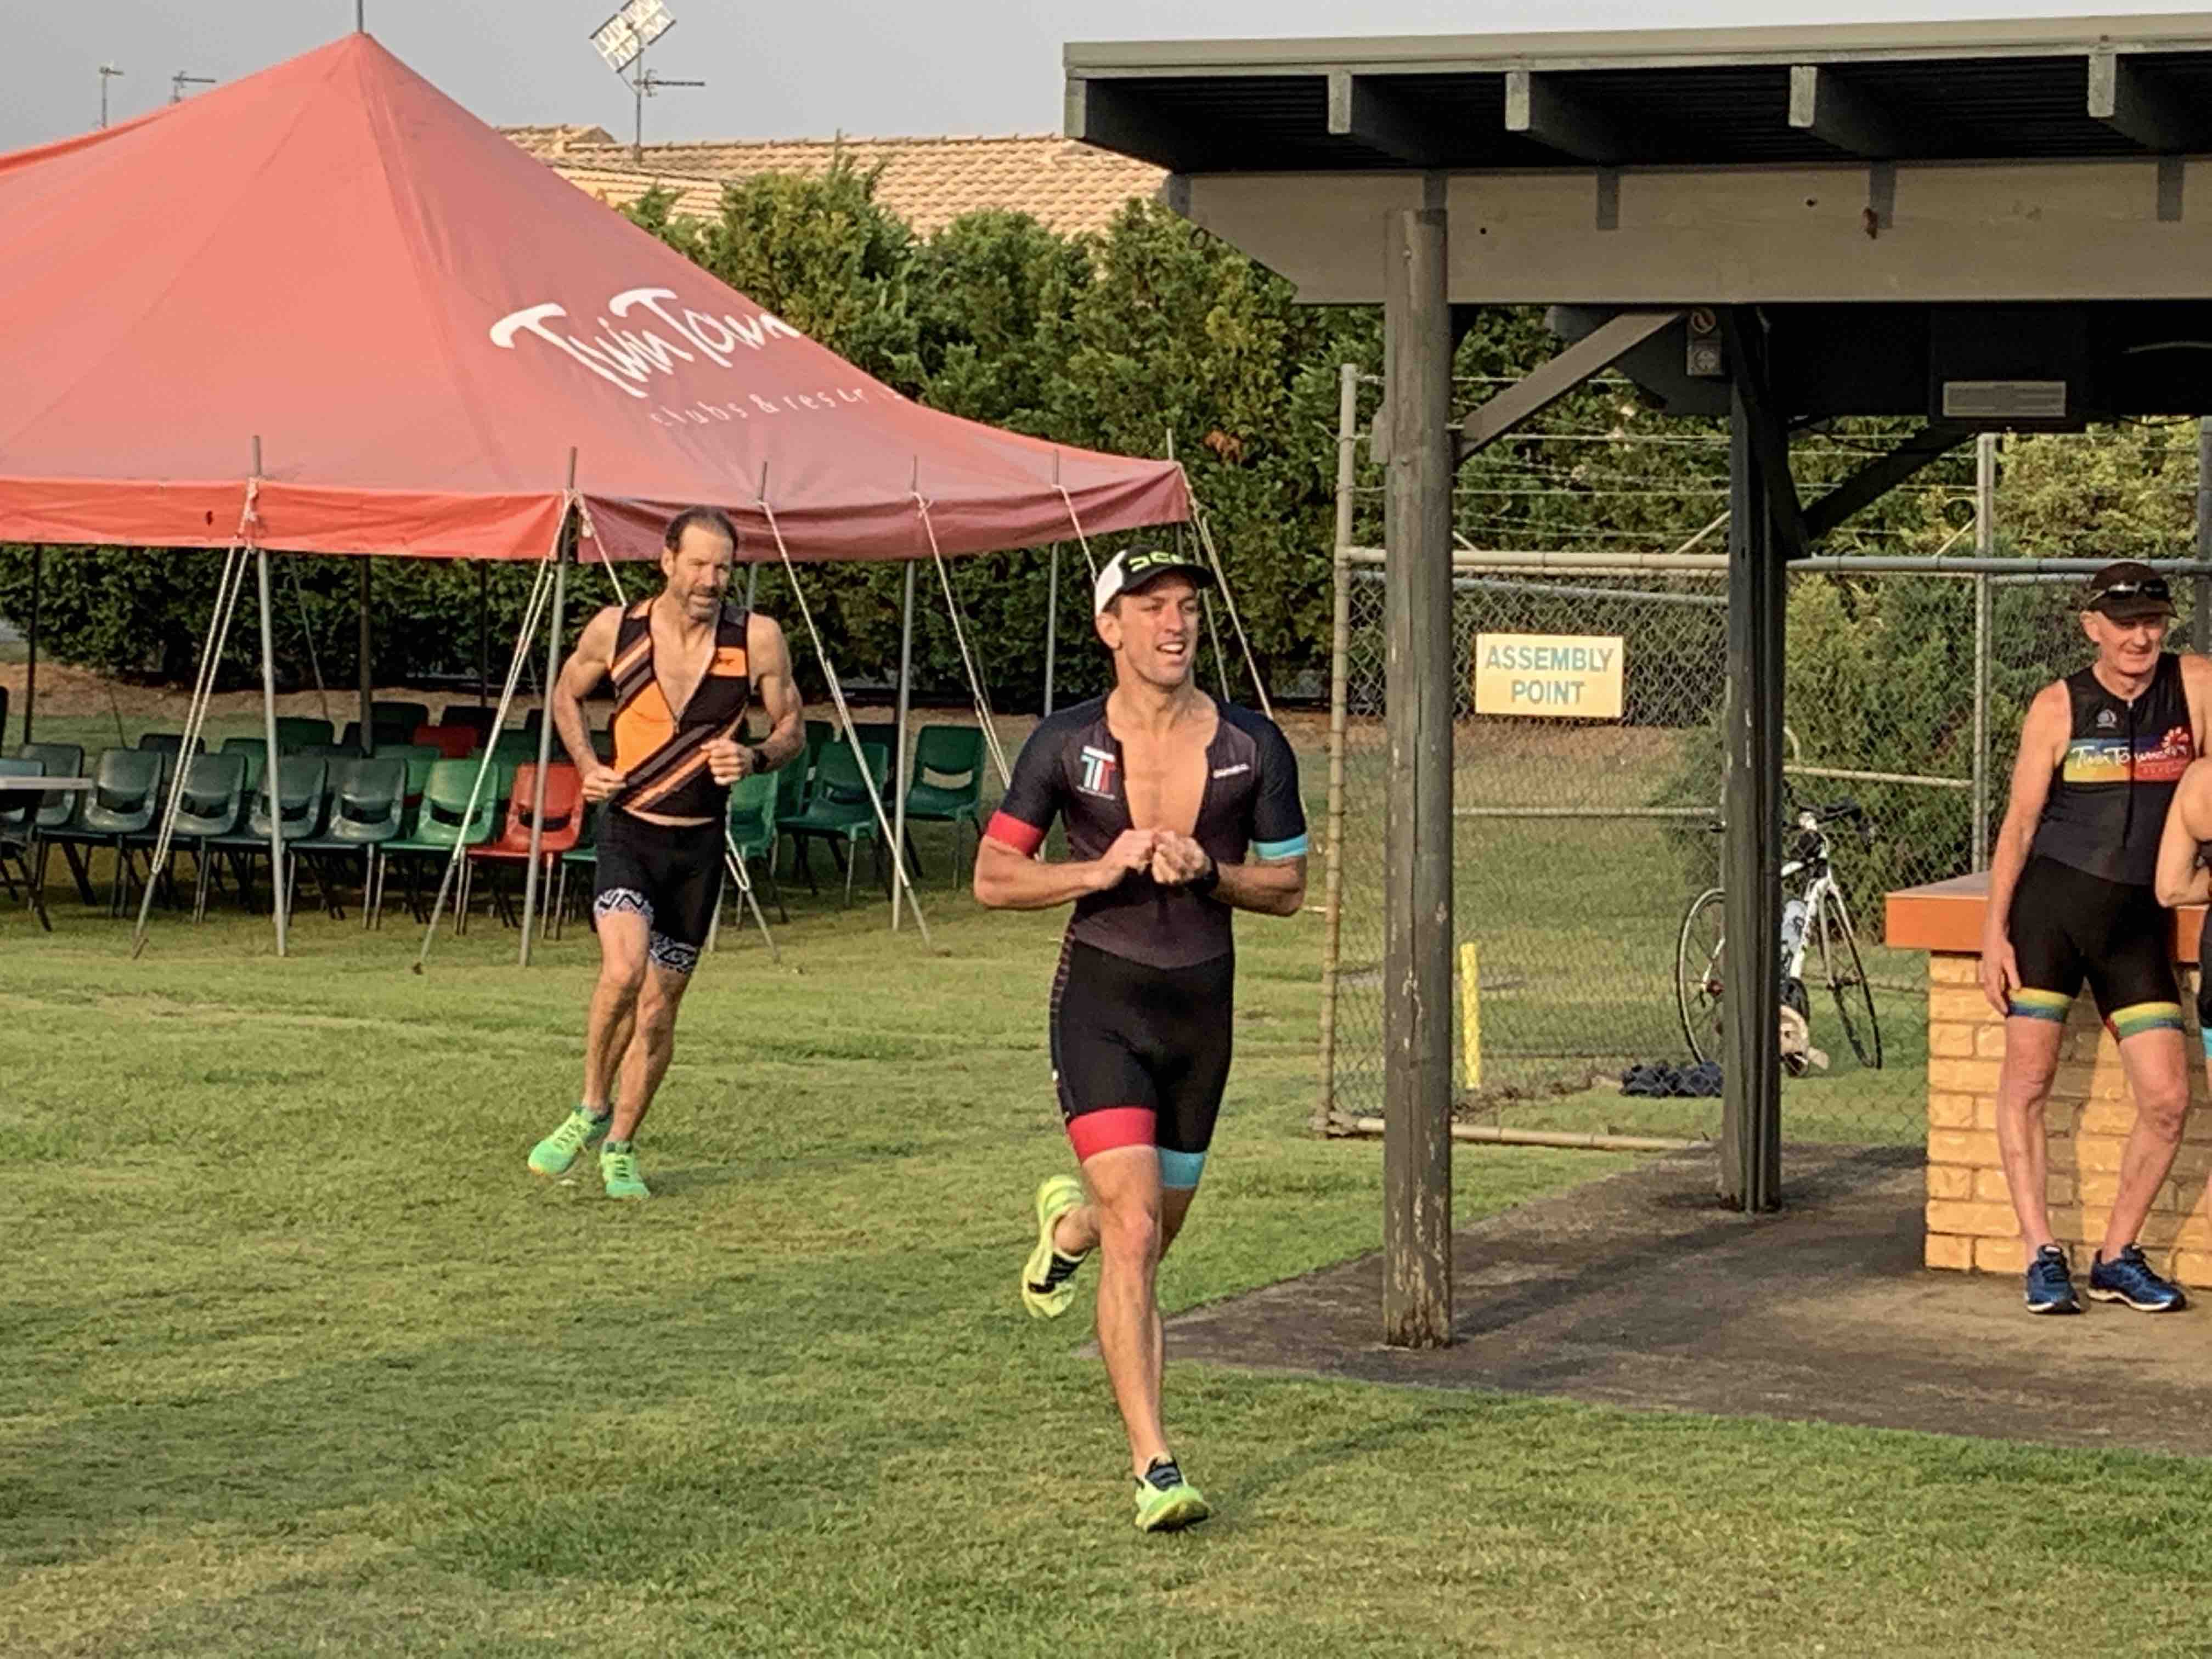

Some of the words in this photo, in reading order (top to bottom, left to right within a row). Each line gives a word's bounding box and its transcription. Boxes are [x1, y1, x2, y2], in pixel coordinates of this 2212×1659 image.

[490, 302, 694, 398] Twin
[748, 393, 781, 413] &
[1485, 645, 1614, 672] ASSEMBLY
[1511, 680, 1586, 705] POINT
